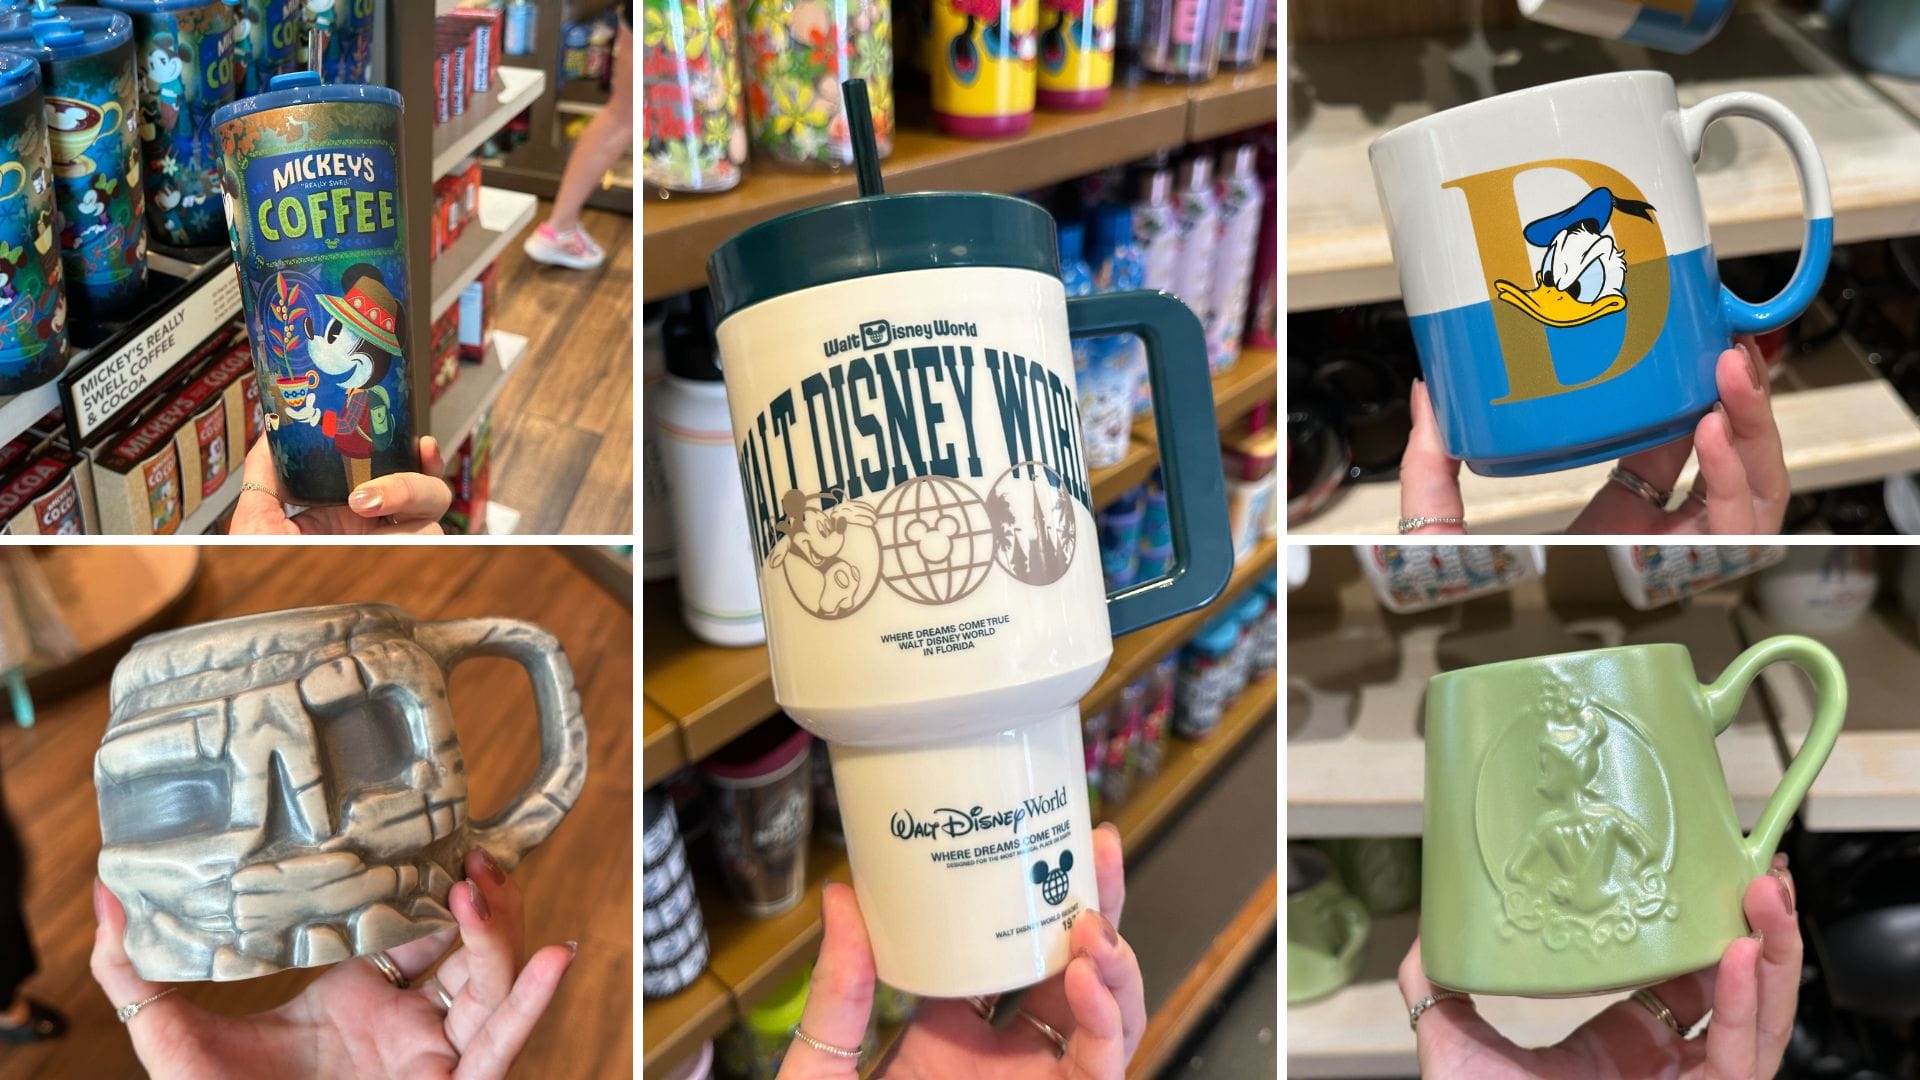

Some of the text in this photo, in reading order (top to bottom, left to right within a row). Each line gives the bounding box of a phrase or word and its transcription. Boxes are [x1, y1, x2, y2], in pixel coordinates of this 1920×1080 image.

[272, 153, 375, 192] MICKEY'S
[258, 187, 395, 241] COFFEE
[1441, 158, 1671, 406] D
[80, 308, 186, 397] MICKEY'S REALLY
[823, 333, 861, 357] Walt
[934, 319, 977, 338] World
[83, 334, 176, 412] SWELL COFFEE
[86, 374, 147, 427] & COCOA
[801, 346, 983, 508] DISNEY
[880, 614, 1010, 643] WHERE DREAMS COME TRUE
[898, 627, 996, 650] WALT DISNEY WORLD
[923, 641, 975, 656] IN FLORIDA
[1023, 785, 1067, 818] World
[931, 819, 1070, 862] WHERE DREAMS COME TRUE
[976, 857, 988, 865] FOR
[995, 928, 1014, 938] WALT
[1040, 912, 1061, 926] WORLD
